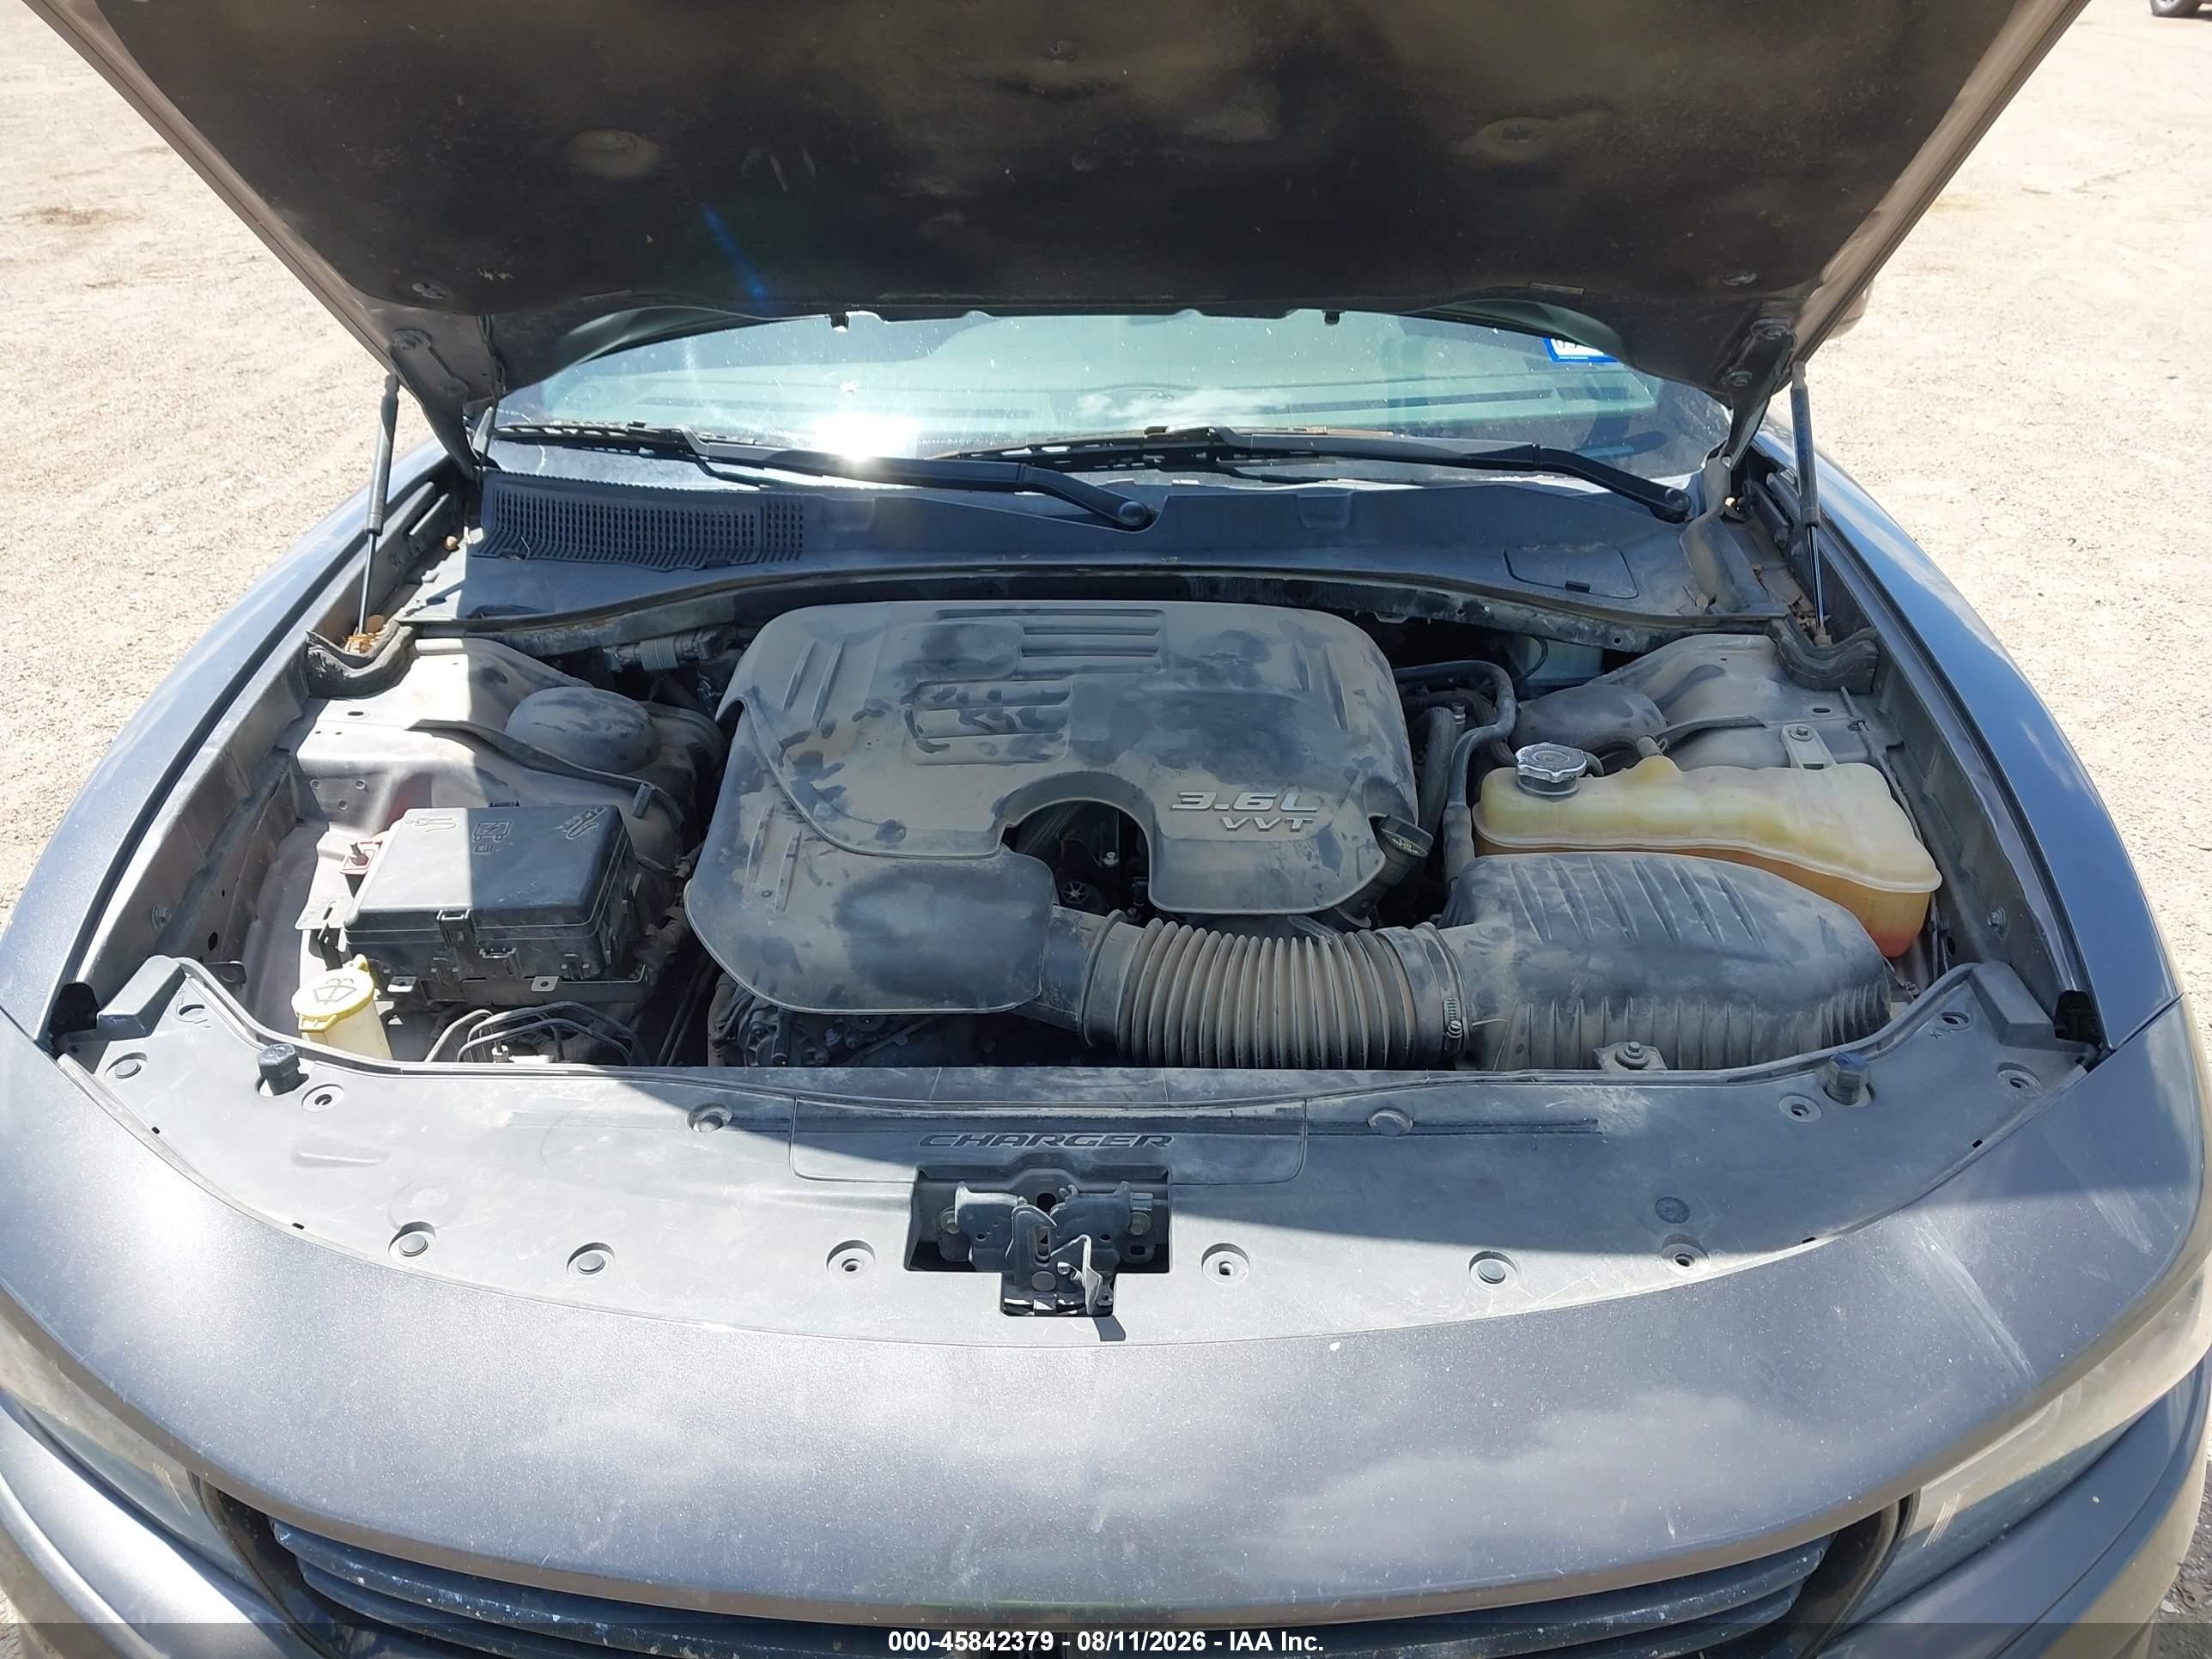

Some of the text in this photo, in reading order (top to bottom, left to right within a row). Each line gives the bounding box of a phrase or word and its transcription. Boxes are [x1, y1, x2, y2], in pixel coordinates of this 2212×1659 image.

[1170, 791, 1319, 811] 3.6L
[1219, 817, 1314, 832] VVT
[917, 1133, 1176, 1148] CHARGER
